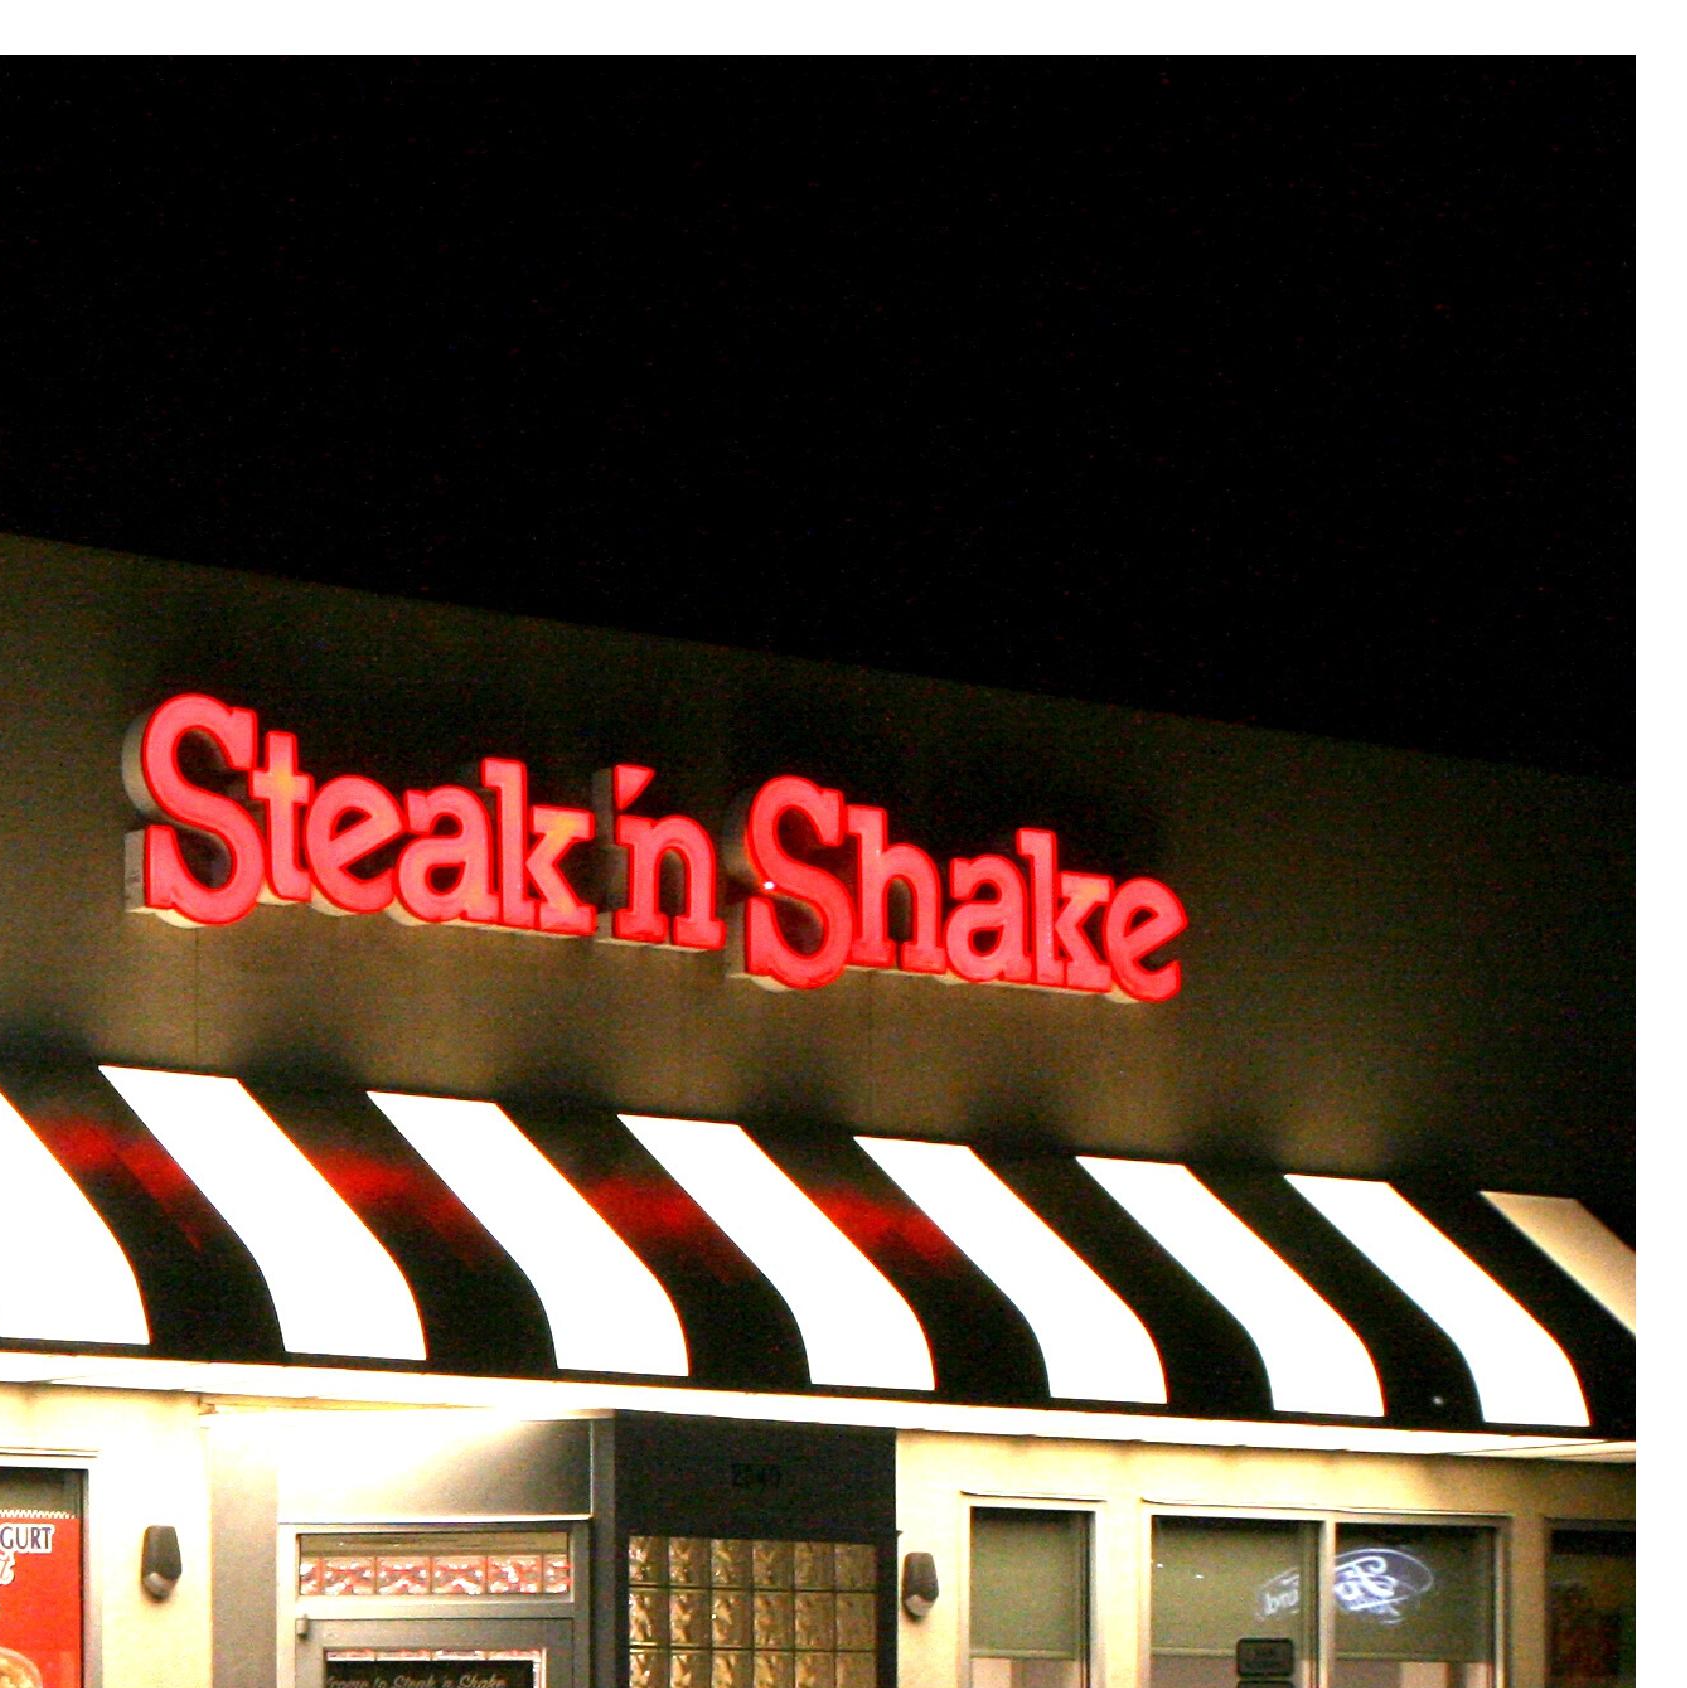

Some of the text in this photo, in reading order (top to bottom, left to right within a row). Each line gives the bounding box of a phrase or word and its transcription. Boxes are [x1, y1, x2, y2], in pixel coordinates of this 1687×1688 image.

[140, 692, 1189, 1002] Steak 'n Shake
